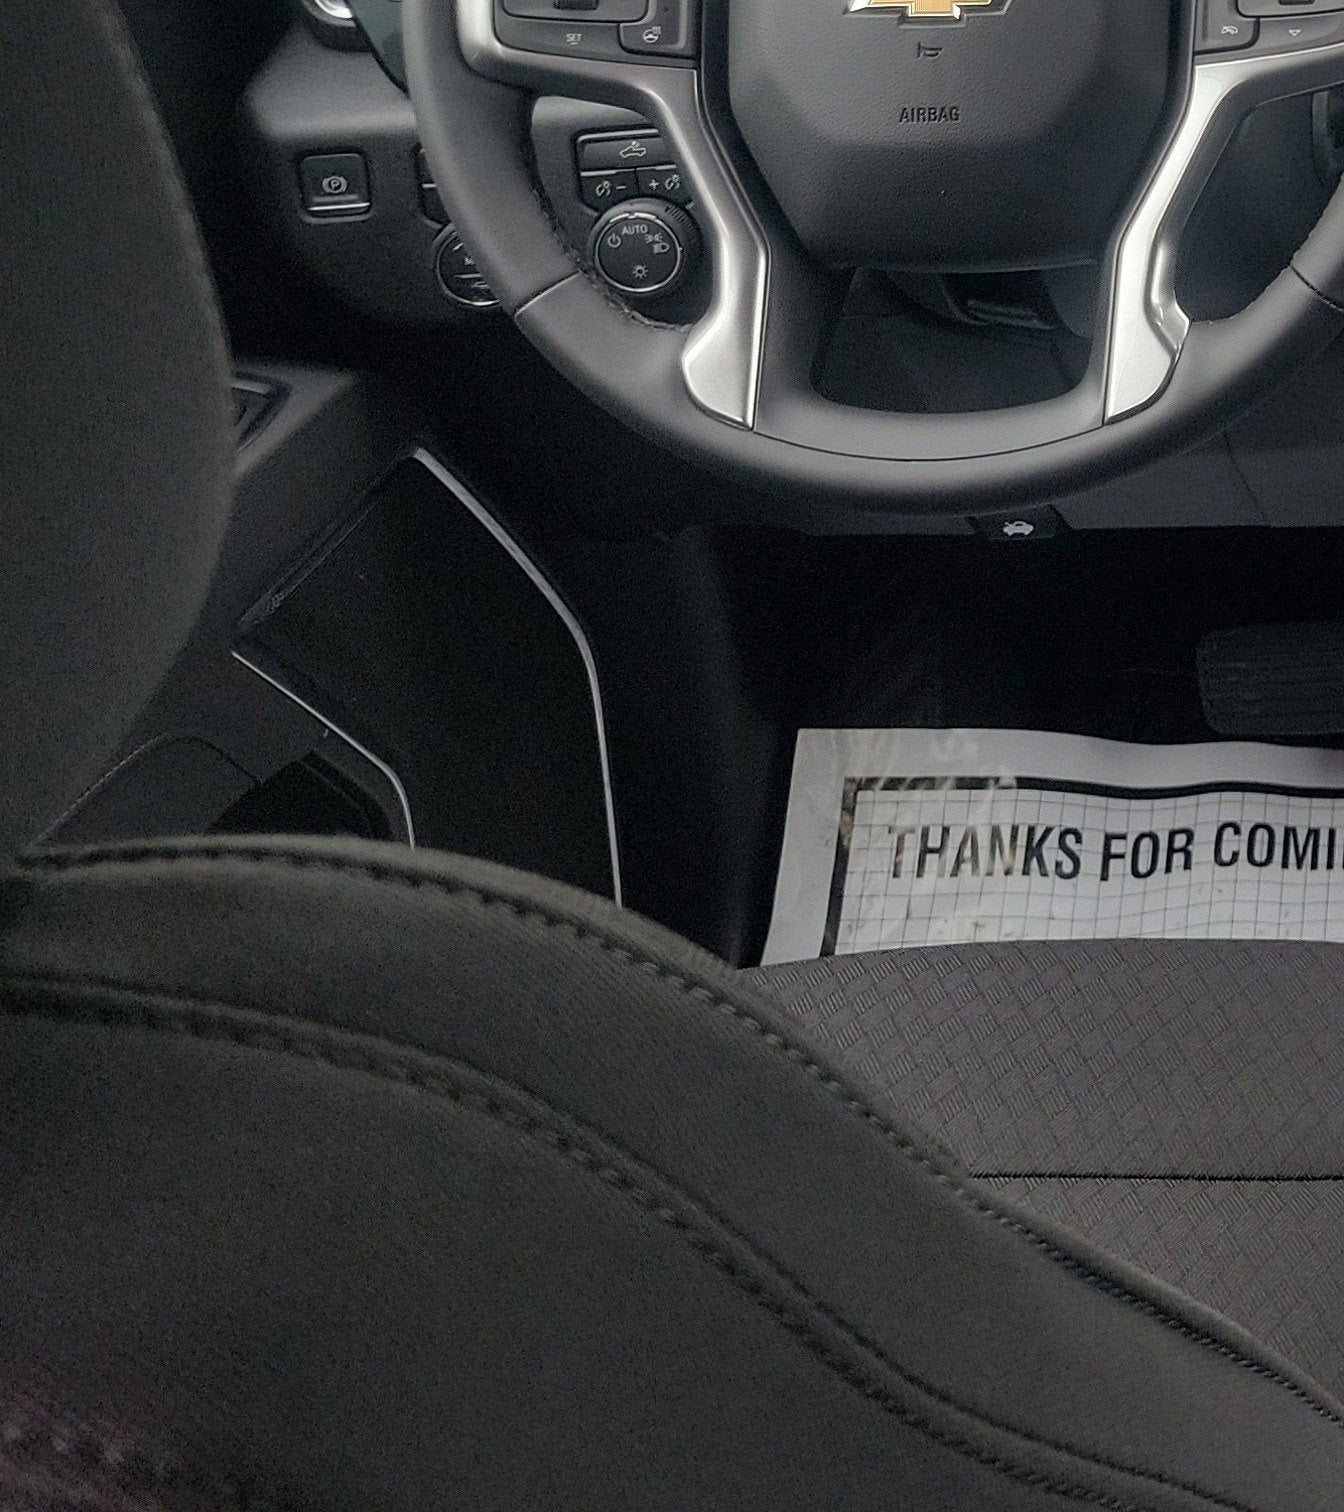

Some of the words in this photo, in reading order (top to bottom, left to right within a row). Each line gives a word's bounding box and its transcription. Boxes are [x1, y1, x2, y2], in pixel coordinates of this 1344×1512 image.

[900, 106, 960, 124] AIRBAG
[621, 224, 648, 236] AUTO
[888, 825, 1083, 880] THANKS
[1100, 827, 1195, 882] FOR
